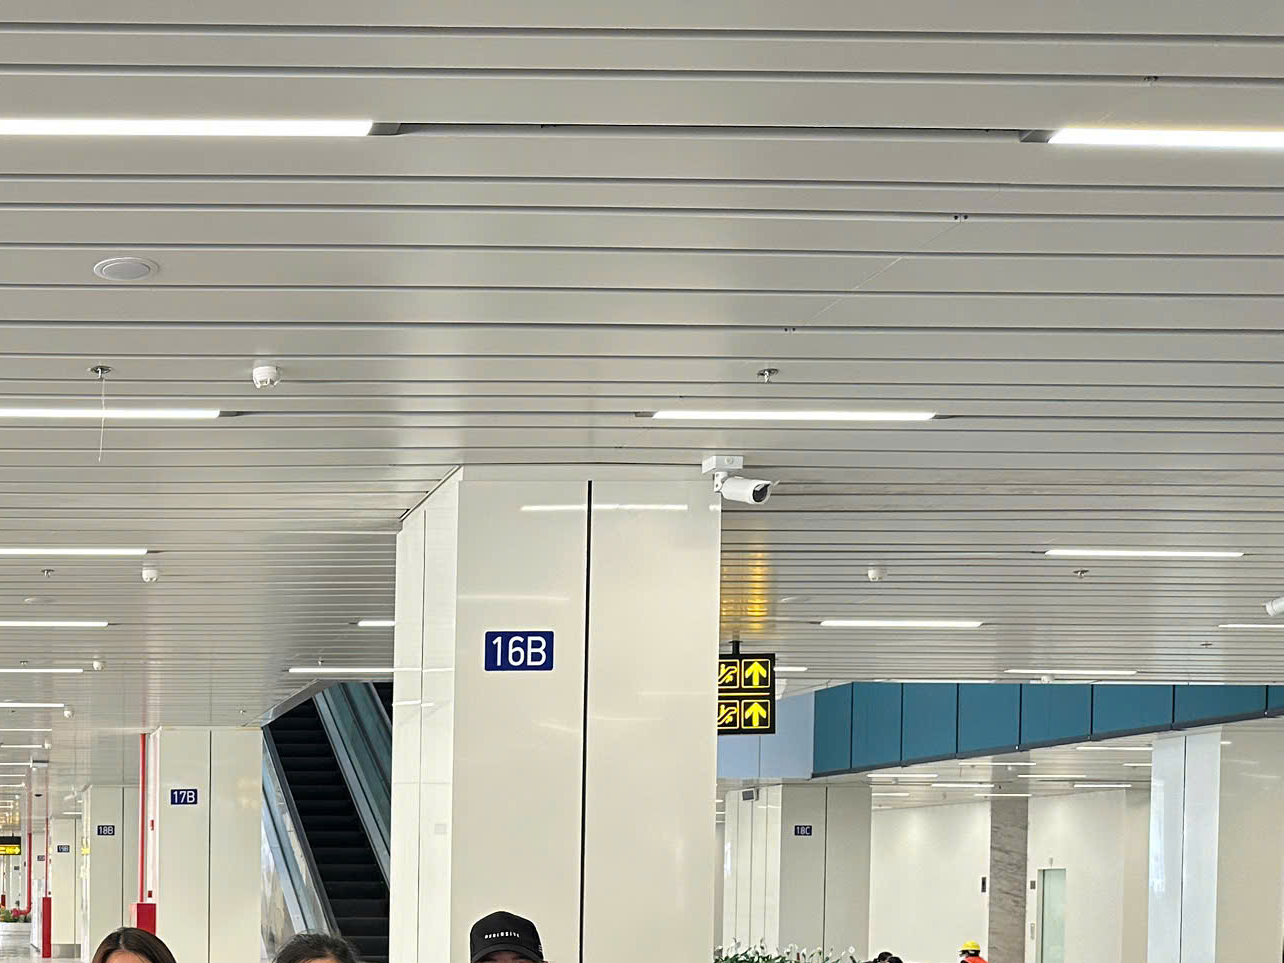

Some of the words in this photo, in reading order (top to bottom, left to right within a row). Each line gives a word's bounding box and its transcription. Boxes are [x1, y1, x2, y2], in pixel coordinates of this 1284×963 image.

[492, 636, 546, 666] 16B
[173, 791, 196, 803] 17B
[99, 826, 113, 835] 18B
[796, 826, 810, 835] 18C
